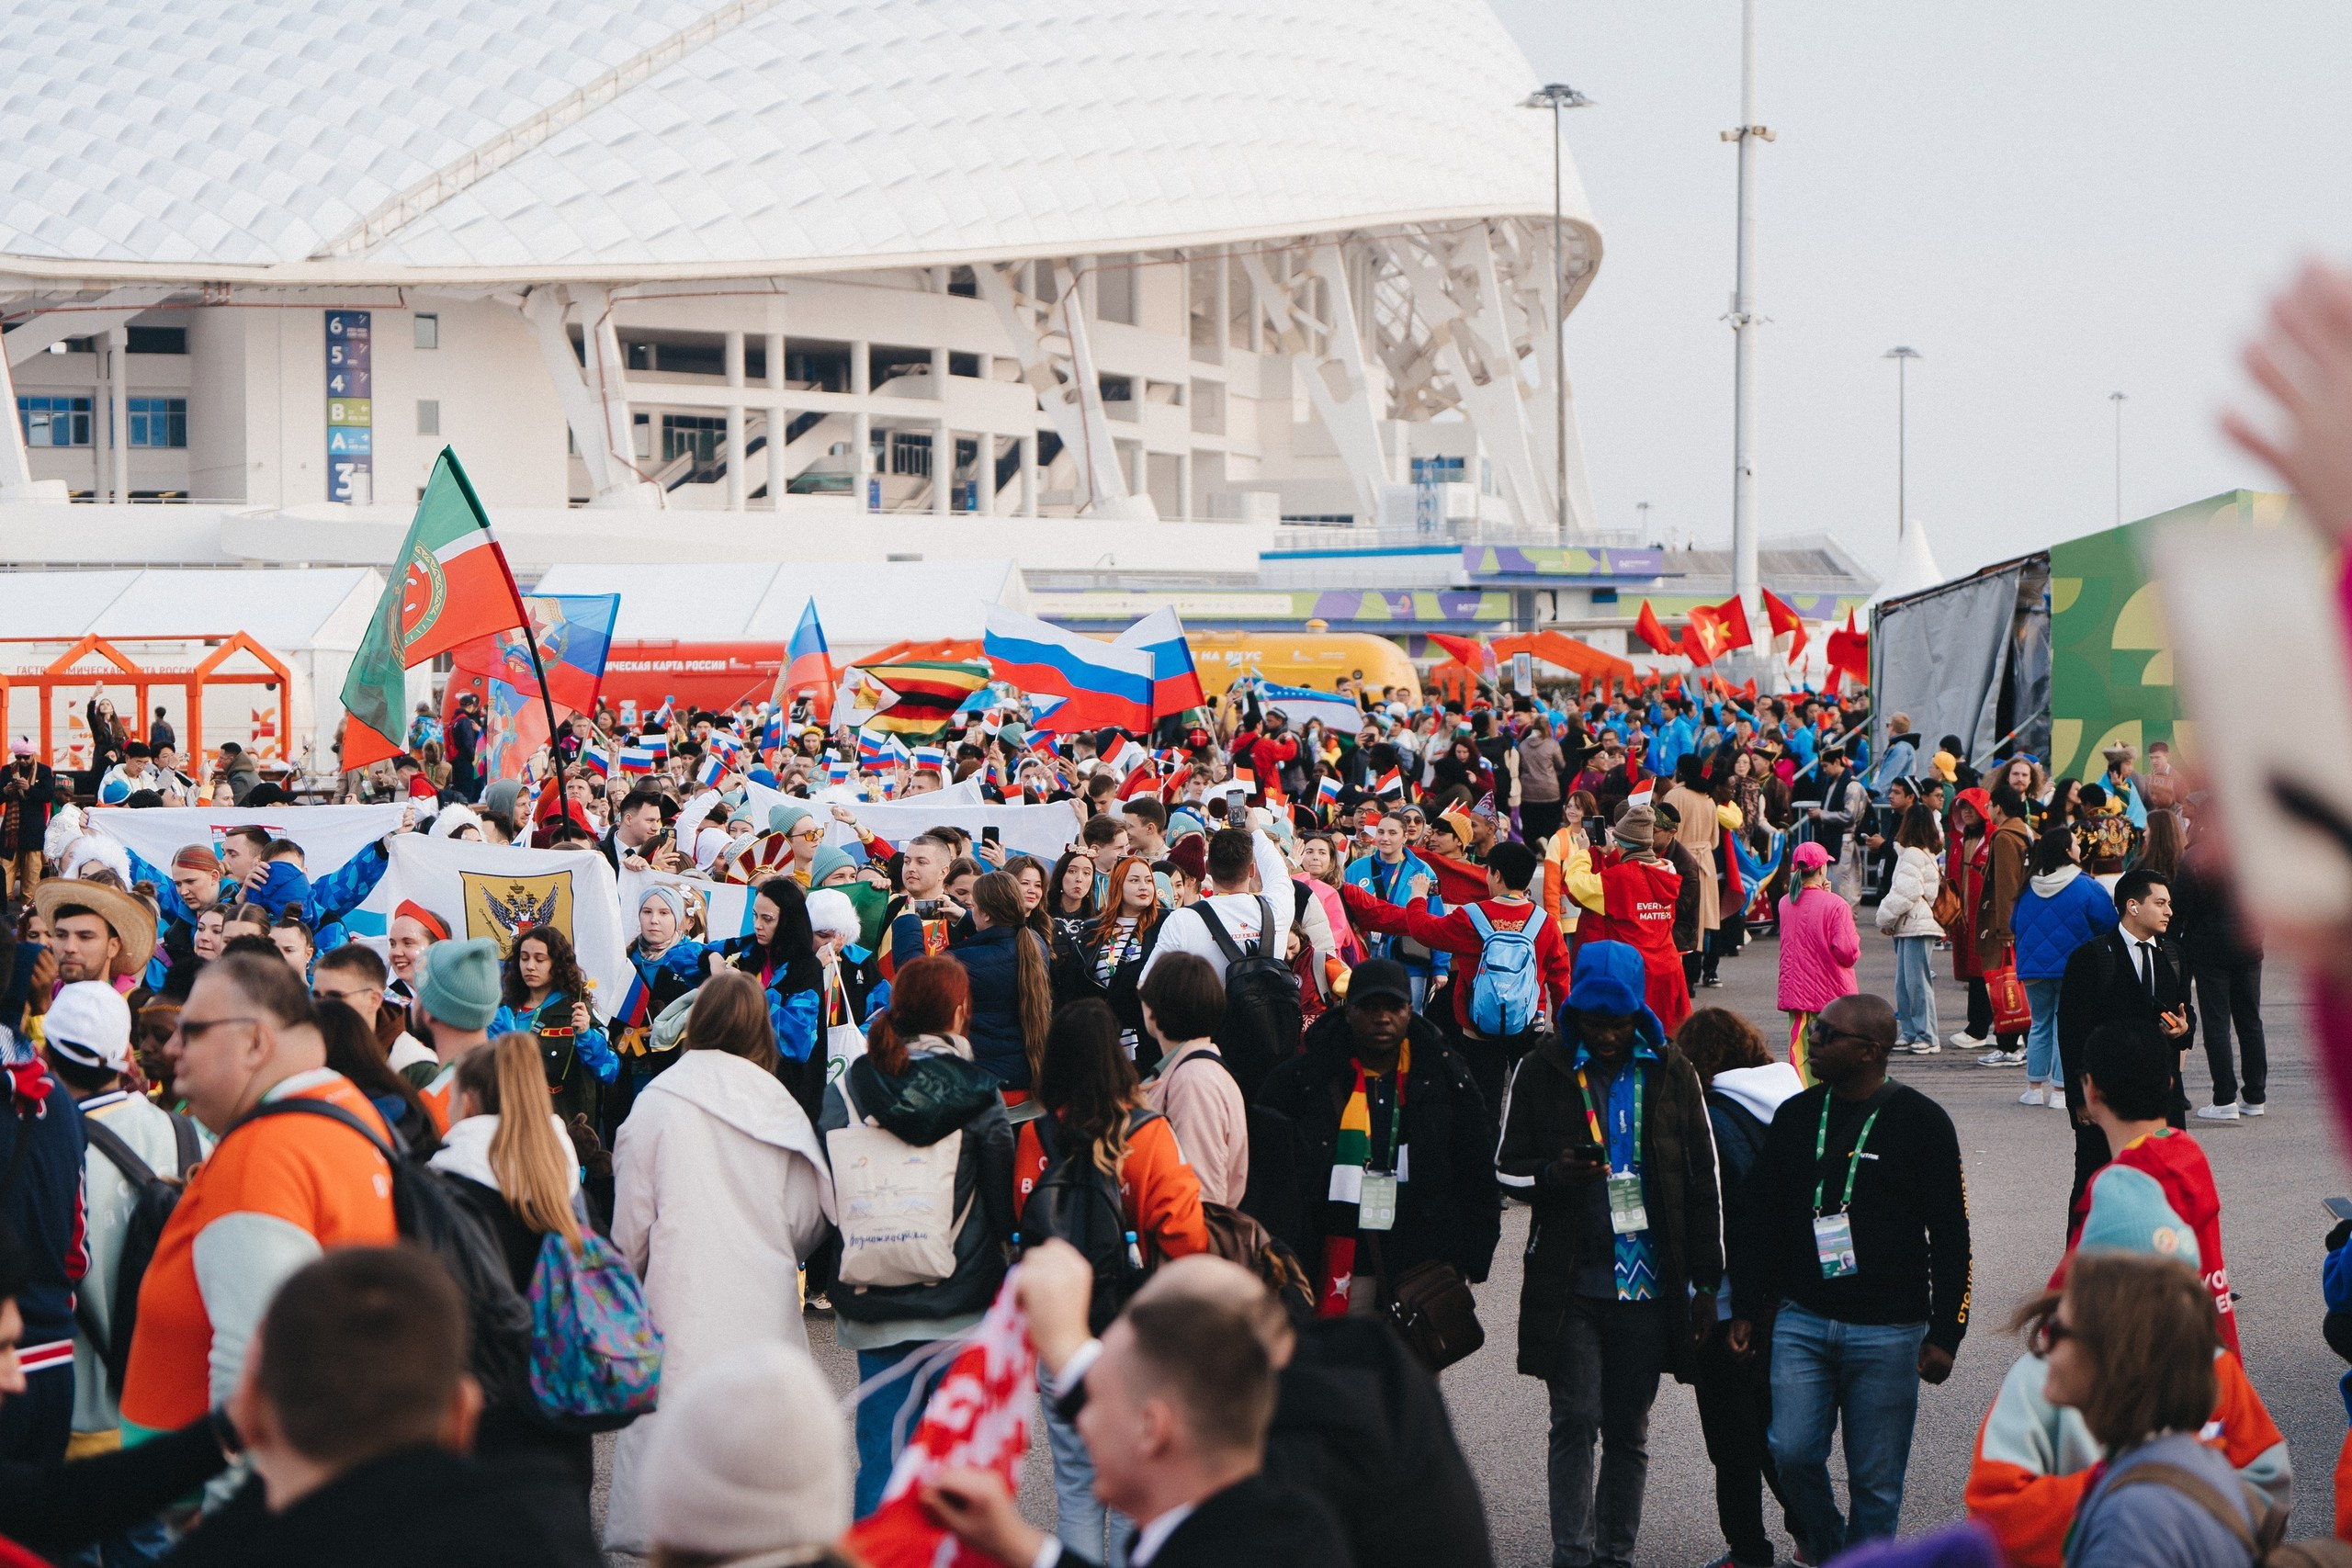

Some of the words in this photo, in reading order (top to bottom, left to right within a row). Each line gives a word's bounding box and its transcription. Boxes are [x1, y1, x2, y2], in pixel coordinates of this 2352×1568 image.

[330, 317, 343, 335] 6
[332, 345, 343, 365] 5
[331, 374, 345, 392] 4
[332, 403, 345, 421] B
[332, 432, 345, 450] A
[335, 462, 355, 498] 3
[160, 665, 195, 675] РОССИ
[653, 660, 684, 671] КАРТА
[685, 660, 726, 671] РОССИИ
